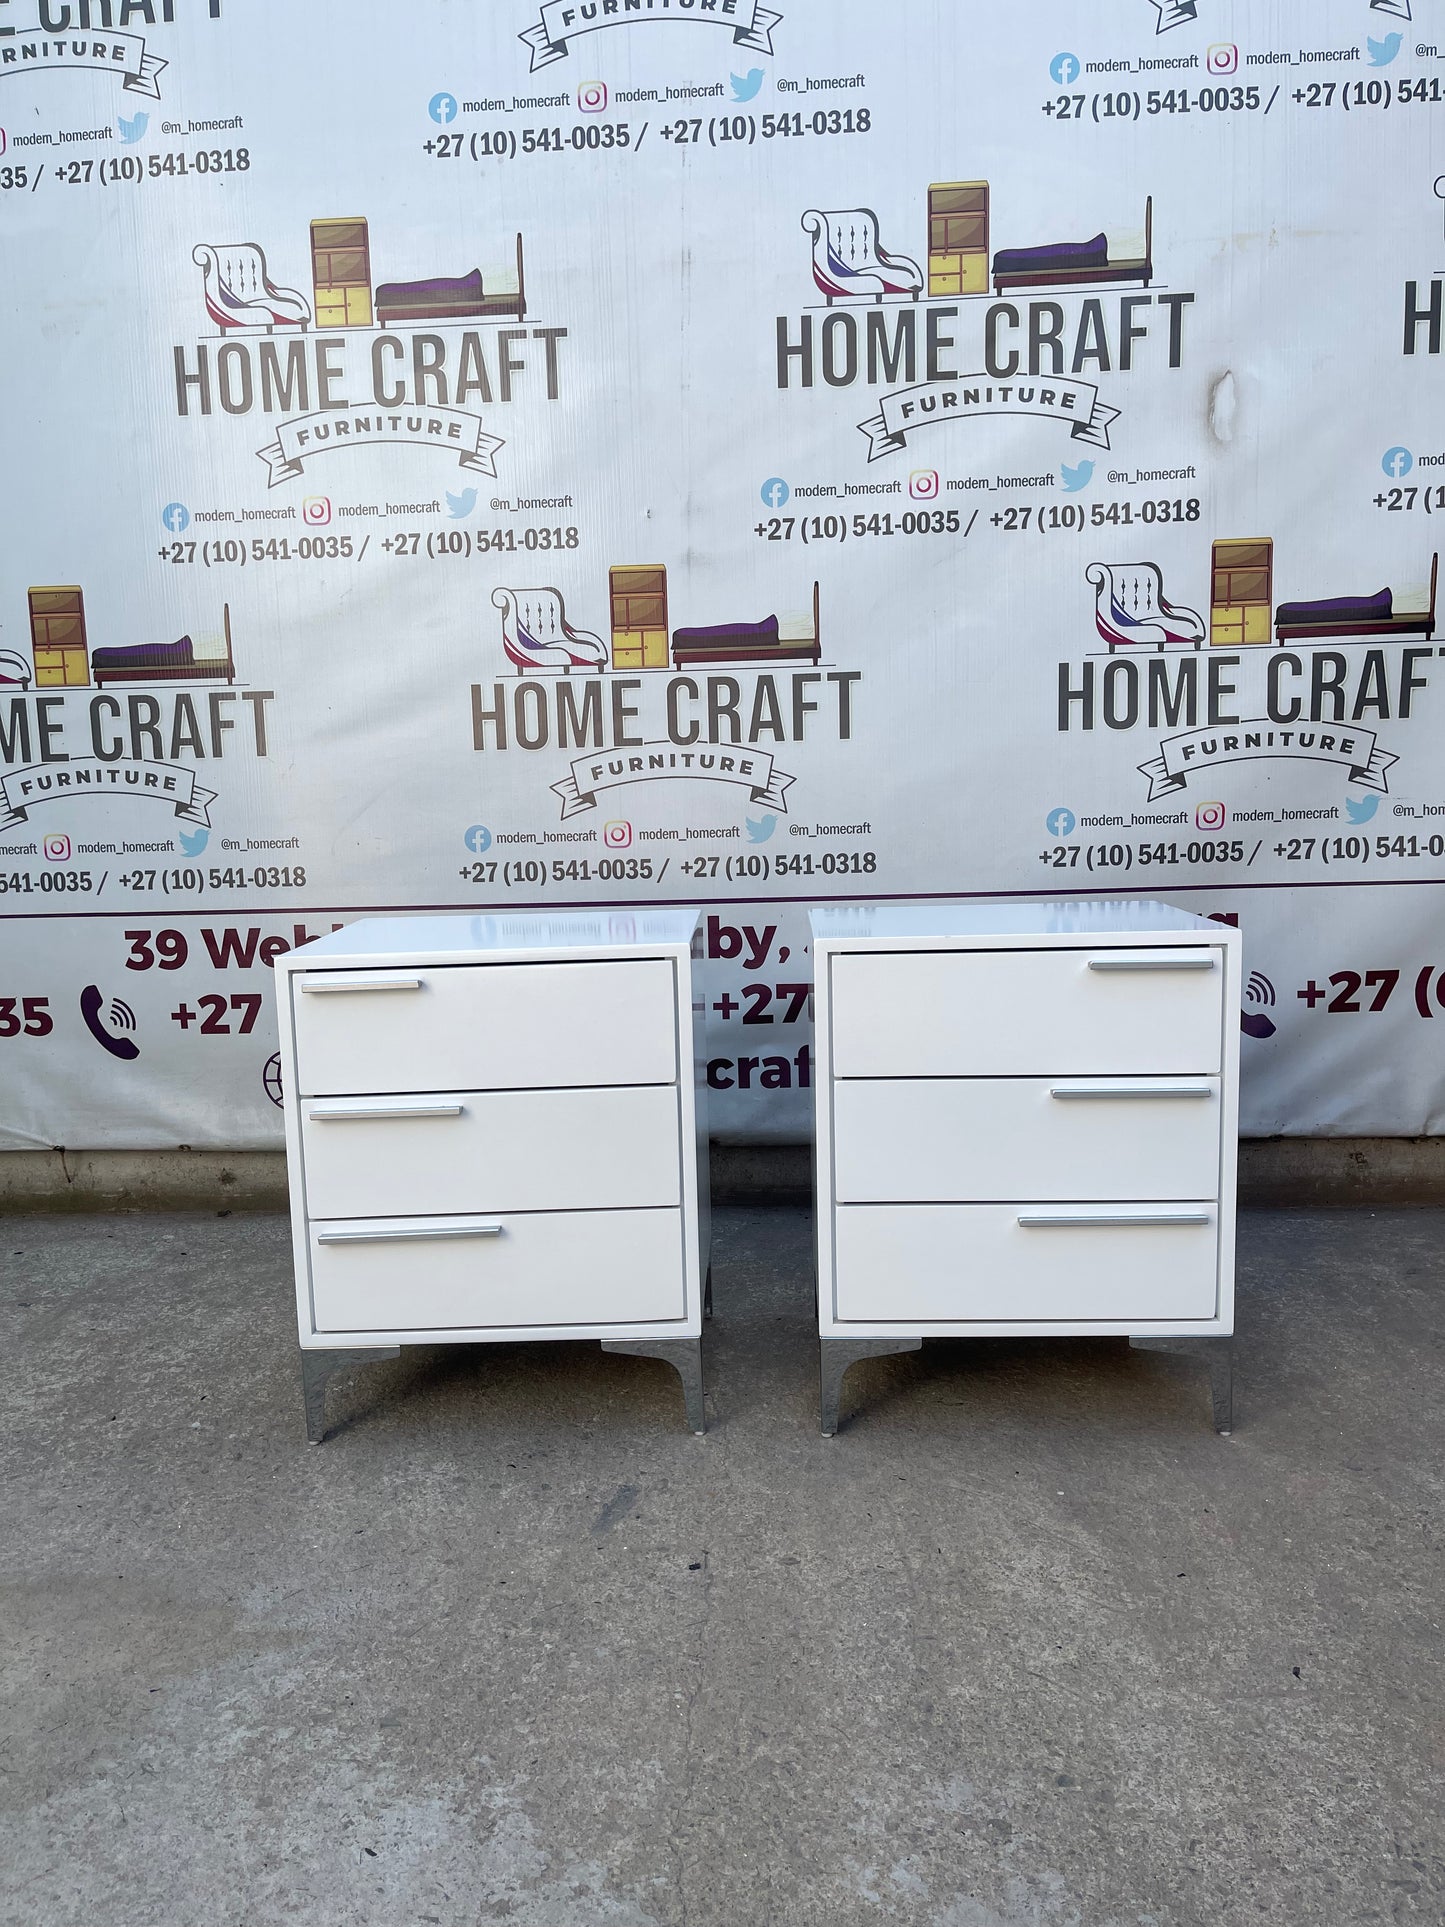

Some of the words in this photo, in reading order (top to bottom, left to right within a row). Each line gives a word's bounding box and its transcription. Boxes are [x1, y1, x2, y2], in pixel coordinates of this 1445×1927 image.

[777, 74, 865, 93] @m_homecraft
[1042, 95, 1086, 119] +27
[1092, 92, 1140, 123] (10)
[1147, 86, 1260, 114] 541-0035
[1292, 83, 1336, 107] +27
[1343, 80, 1391, 111] (10)
[162, 116, 243, 135] @m_homecraft
[423, 134, 464, 158] +27
[470, 131, 516, 161] (10)
[522, 123, 630, 153] 541-0035
[660, 119, 702, 143] +27
[709, 116, 755, 147] (10)
[762, 108, 871, 138] 541-0318
[55, 160, 93, 184] +27
[100, 156, 143, 186] (10)
[149, 148, 250, 177] 541-0318
[776, 305, 960, 391] HOME
[982, 291, 1197, 381] CRAFT
[174, 336, 351, 418] HOME
[369, 325, 567, 409] CRAFT
[899, 384, 1078, 421] FURNITURE
[294, 414, 461, 448] FURNITURE
[1107, 466, 1196, 484] @m_homecraft
[490, 495, 573, 512] @m_homecraft
[1373, 487, 1418, 511] +27
[754, 518, 795, 540] +27
[801, 516, 847, 544] (10)
[853, 510, 960, 537] 541-0035
[990, 507, 1032, 530] +27
[1038, 505, 1085, 534] (10)
[1091, 498, 1200, 526] 541-0318
[158, 542, 196, 563] +27
[203, 540, 246, 567] (10)
[252, 536, 353, 561] 541-0035
[382, 533, 420, 555] +27
[427, 531, 471, 559] (10)
[477, 527, 579, 552] 541-0318
[1058, 654, 1242, 733] HOME
[1265, 646, 1445, 726] CRAF
[88, 689, 274, 763] CRAFT
[471, 677, 646, 753] HOME
[665, 669, 861, 748] CRAFT
[1180, 730, 1355, 762] FURNITURE
[19, 767, 179, 797] FURNITURE
[589, 752, 753, 783] FURNITURE
[221, 837, 299, 852] @m_homecraft
[789, 822, 871, 839] @m_homecraft
[459, 862, 497, 883] +27
[504, 861, 547, 887] (10)
[552, 859, 652, 881] 541-0035
[681, 857, 720, 877] +27
[726, 856, 769, 881] (10)
[775, 852, 876, 875] 541-0318
[1039, 846, 1080, 867] +27
[1087, 845, 1132, 871] (10)
[1138, 841, 1243, 865] 541-0035
[1274, 838, 1316, 860] +27
[1322, 837, 1369, 864] (10)
[1376, 835, 1445, 858] 541-0
[119, 870, 156, 890] +27
[162, 869, 204, 894] (10)
[209, 866, 306, 889] 541-0318
[124, 929, 188, 971] 39
[171, 993, 264, 1034] +27
[1297, 970, 1400, 1013] +27
